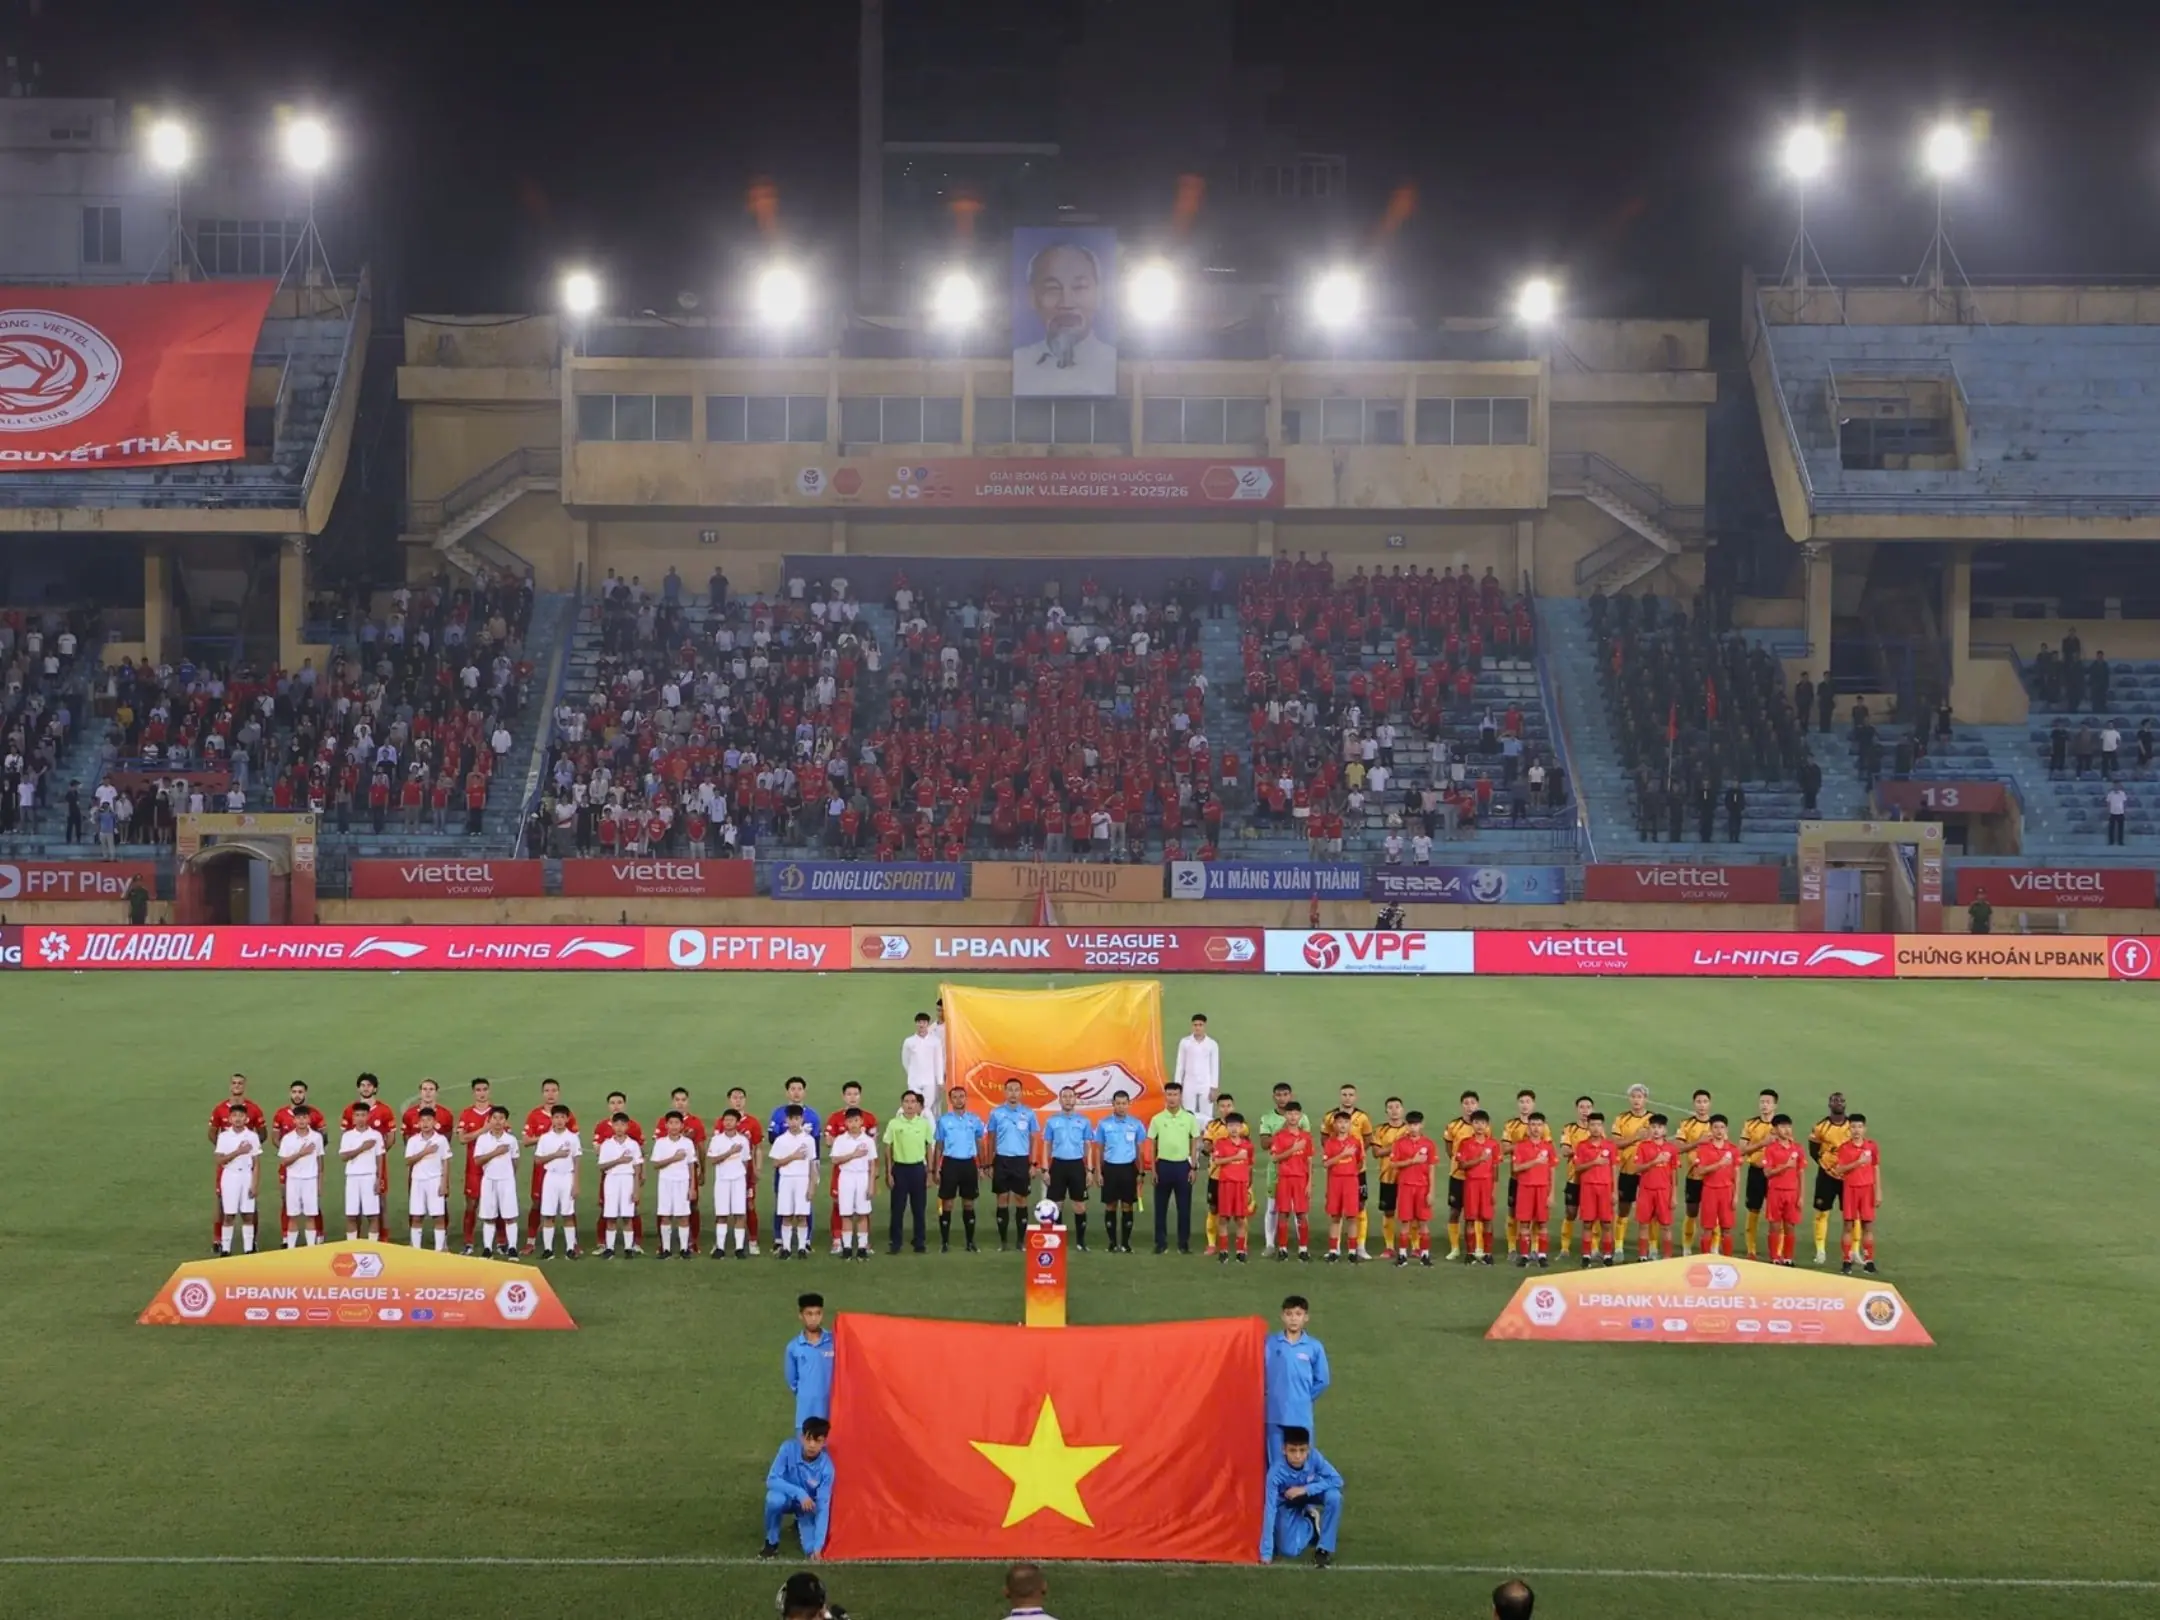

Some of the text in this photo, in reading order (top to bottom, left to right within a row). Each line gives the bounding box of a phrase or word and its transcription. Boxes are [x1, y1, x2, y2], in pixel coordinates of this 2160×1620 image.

[43, 321, 89, 348] VIETTEL
[116, 431, 232, 455] THẮNG
[1155, 472, 1175, 483] GIA
[975, 485, 1035, 497] LPBANK
[1039, 485, 1109, 497] V.LEAGUE
[1129, 486, 1189, 499] 2025/26
[1922, 787, 1959, 807] 13
[401, 864, 494, 883] viettel
[612, 861, 705, 880] viettel
[1209, 866, 1361, 890] XI MĂNG XUÂN THÀNH
[1636, 867, 1730, 886] viettel
[2009, 870, 2105, 890] viettel
[27, 870, 133, 899] FPT Play
[812, 870, 956, 891] DONGLUCSPORT.VN
[1376, 875, 1461, 892] TERRA
[447, 886, 494, 895] your way
[77, 933, 216, 961] JOGARBOLA
[240, 942, 344, 958] LI-NING
[447, 943, 552, 958] LI-NING
[934, 937, 1051, 958] LPBANK
[1065, 933, 1180, 949] V.LEAGUE 1
[1344, 932, 1427, 961] VPF
[1527, 936, 1628, 956] viettel
[0, 945, 22, 963] G
[712, 936, 826, 967] FPT Play
[1084, 951, 1160, 967] 2025/26
[1694, 949, 1800, 966] LI-NING
[1897, 946, 2105, 966] CHỨNG KHOÁN LPBANK
[1577, 960, 1629, 969] your way
[225, 1287, 298, 1300] LPBANK
[302, 1287, 388, 1300] V.LEAGUE
[391, 1288, 401, 1300] 1
[414, 1287, 485, 1302] 2025/26
[1578, 1293, 1654, 1308] LPBANK
[1657, 1294, 1746, 1309] V.LEAGUE
[1749, 1296, 1759, 1309] 1
[1772, 1297, 1845, 1312] 2025/26
